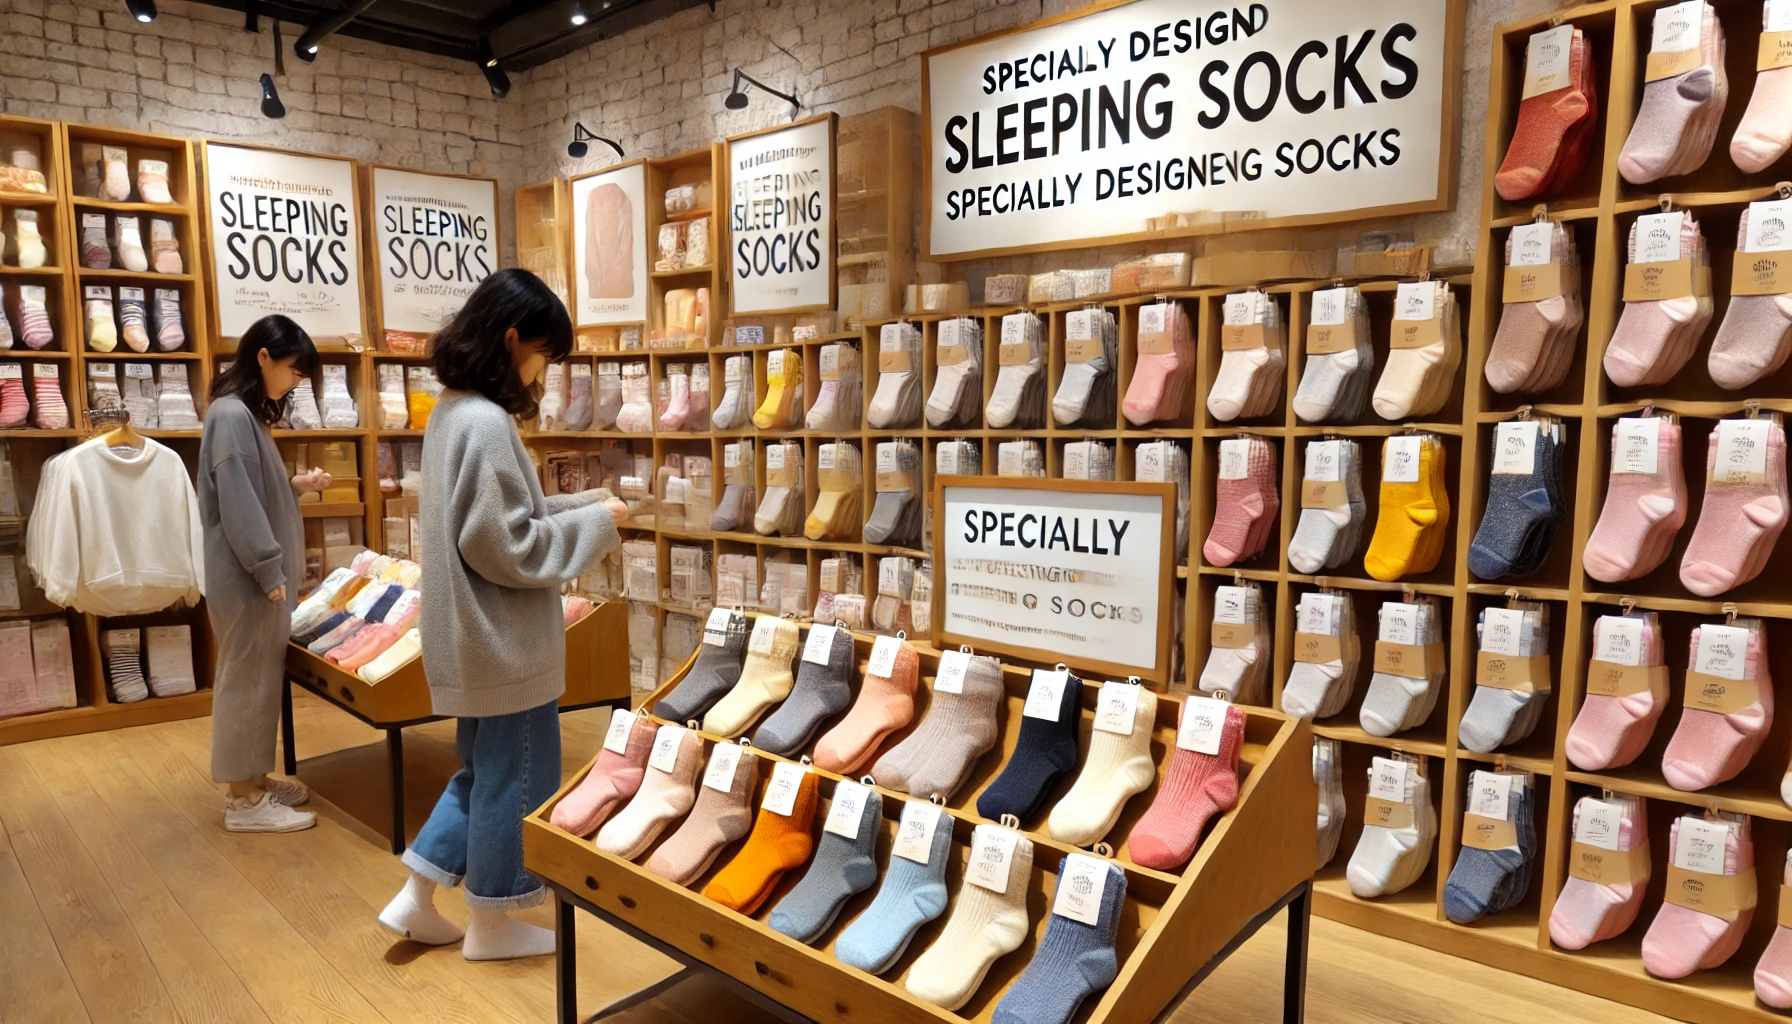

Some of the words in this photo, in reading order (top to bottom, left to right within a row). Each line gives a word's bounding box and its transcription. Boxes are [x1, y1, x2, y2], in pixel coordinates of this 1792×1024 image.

[945, 73, 1173, 174] SLEEPING
[1198, 22, 1419, 129] SOCKS
[946, 173, 1082, 220] SPECIALLY
[1274, 128, 1400, 177] SOCKS
[220, 191, 348, 237] SLEEPING
[384, 205, 487, 242] SLEEPING
[734, 191, 821, 232] SLEEPING
[227, 232, 348, 286] SOCKS
[388, 237, 491, 284] SOCKS
[738, 228, 820, 279] SOCKS
[965, 509, 1130, 556] SPECIALLY
